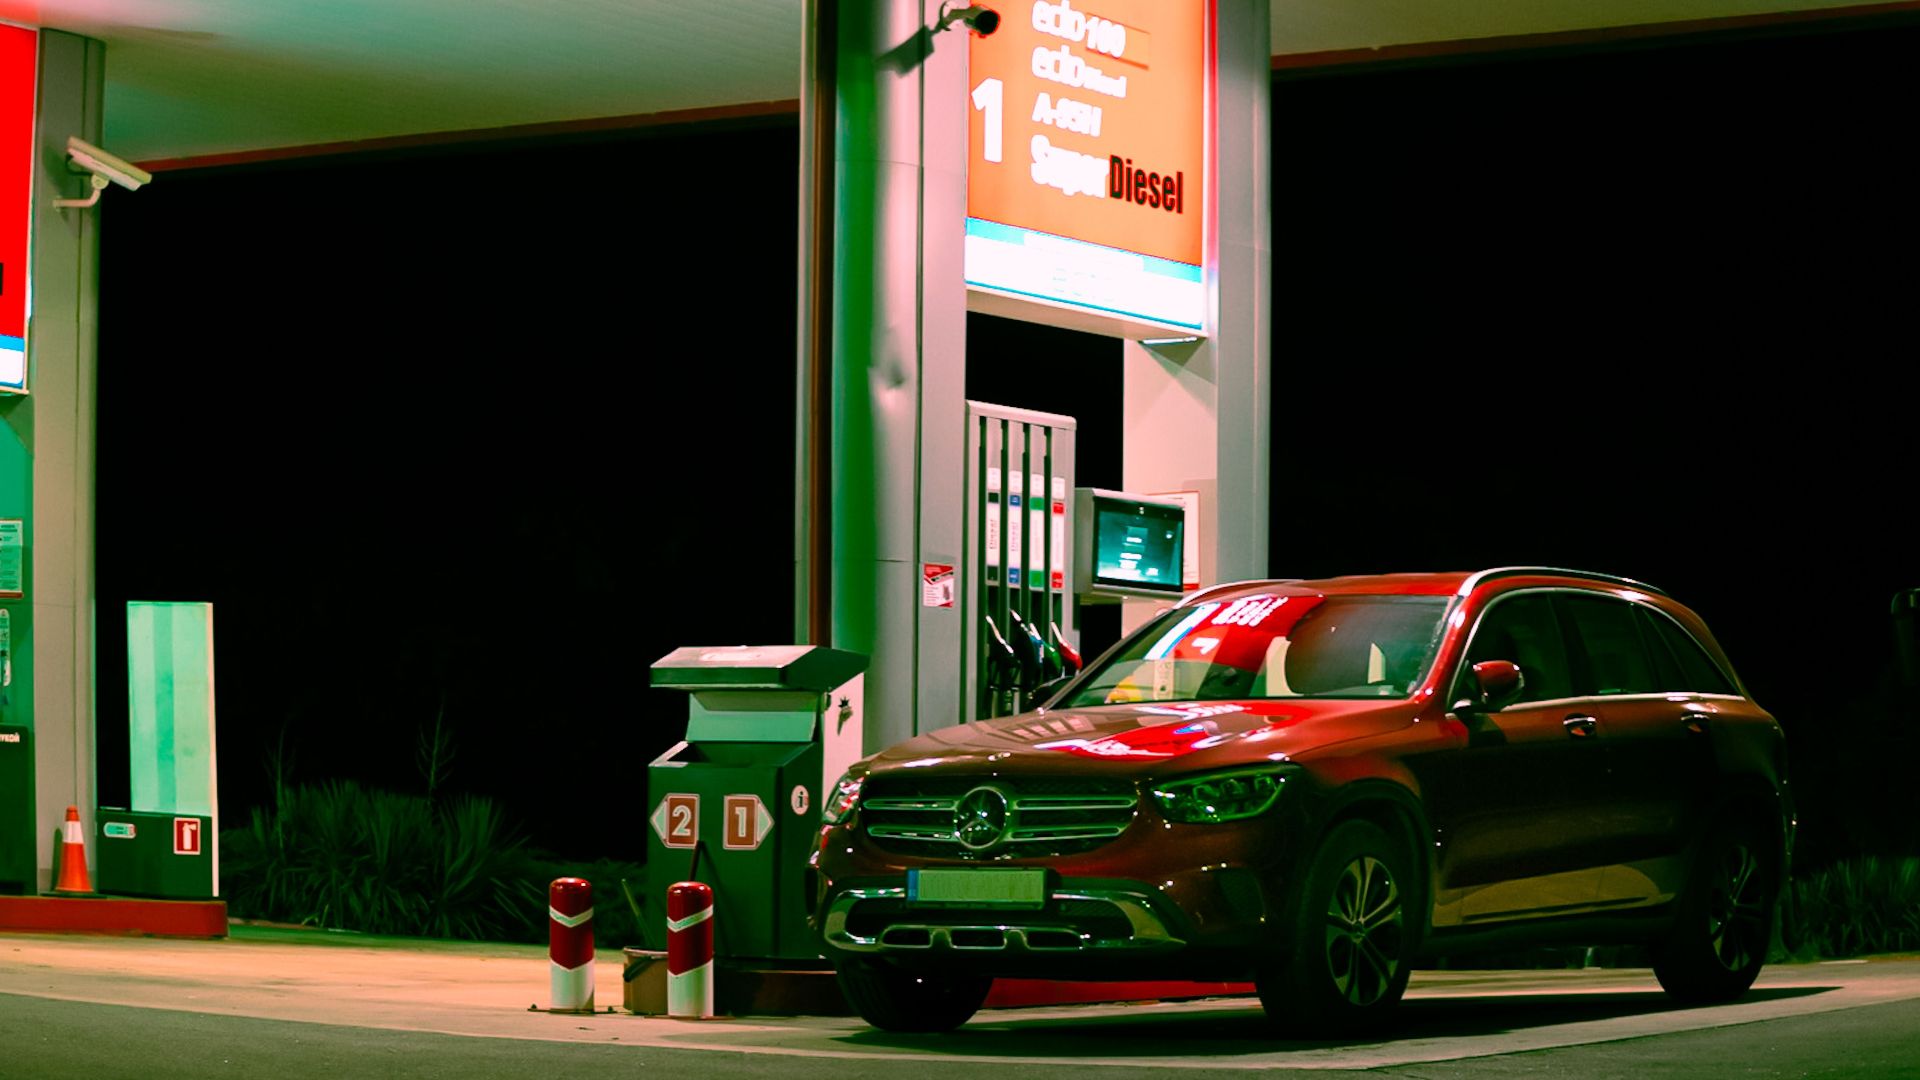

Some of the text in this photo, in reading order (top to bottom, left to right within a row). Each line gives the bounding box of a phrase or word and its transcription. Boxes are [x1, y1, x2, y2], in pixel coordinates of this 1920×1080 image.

[971, 77, 1003, 163] 1
[1109, 154, 1183, 214] Diesel
[671, 804, 692, 836] 2
[734, 806, 747, 838] 1
